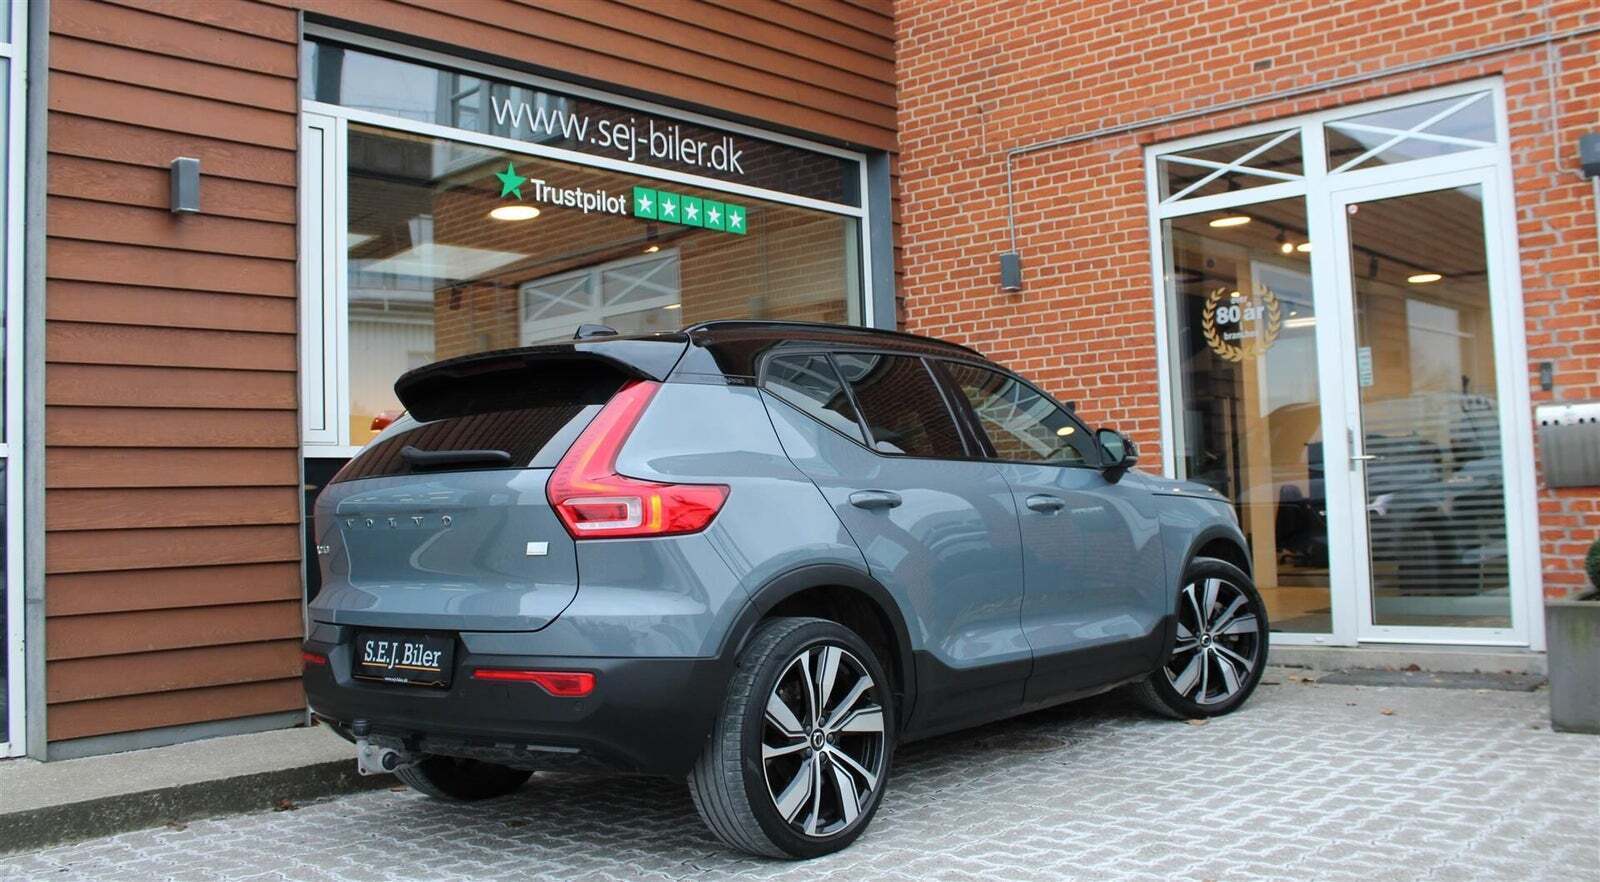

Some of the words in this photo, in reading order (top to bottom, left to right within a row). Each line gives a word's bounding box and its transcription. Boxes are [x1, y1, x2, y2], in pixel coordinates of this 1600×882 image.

[491, 95, 745, 175] www.sej-biler.dk
[530, 178, 627, 215] Trustpilot
[1216, 305, 1241, 325] 80
[364, 640, 399, 669] S.E.J.
[401, 642, 442, 667] Biler
